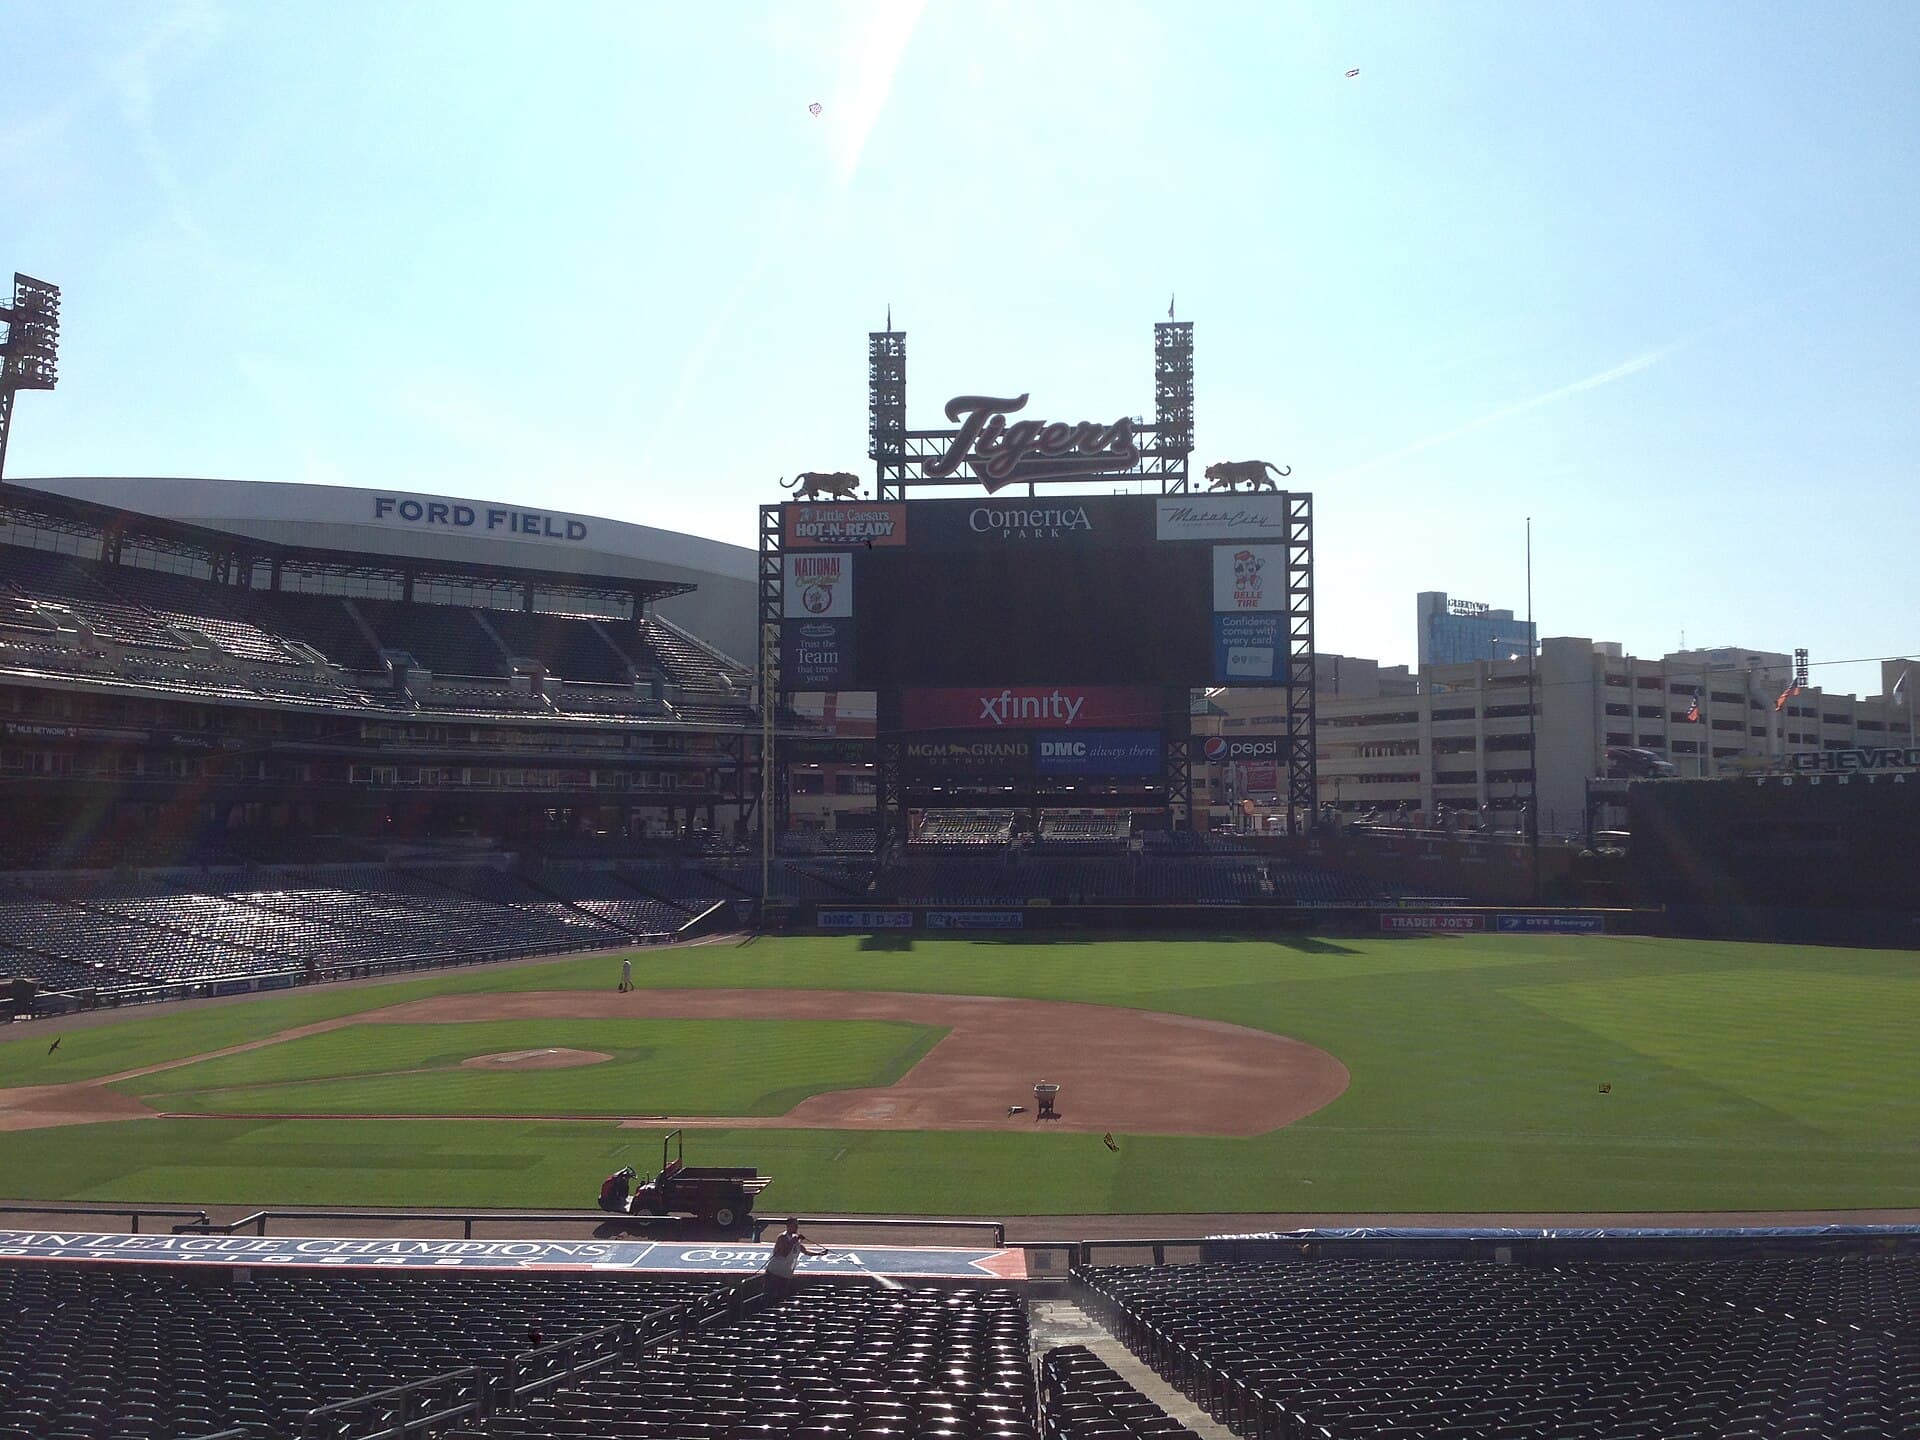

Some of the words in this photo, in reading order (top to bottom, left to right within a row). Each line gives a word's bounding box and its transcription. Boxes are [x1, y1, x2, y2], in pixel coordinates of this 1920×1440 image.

[924, 393, 1140, 482] Tigers
[375, 498, 475, 526] FORD
[488, 510, 587, 540] FIELD
[815, 511, 844, 521] Little
[848, 509, 889, 521] Caesars
[1161, 507, 1230, 522] Motor
[1228, 511, 1280, 527] City
[796, 522, 895, 537] HOT-N-READY
[1003, 529, 1059, 538] PARK
[1233, 591, 1262, 599] BELLE
[1222, 617, 1277, 627] Confidence
[1256, 626, 1277, 635] with
[801, 640, 820, 648] Trust
[823, 640, 836, 648] the
[1222, 638, 1249, 647] every
[796, 648, 839, 664] Team
[798, 665, 814, 673] that
[816, 665, 838, 673] treats
[806, 674, 829, 683] yours
[980, 690, 1084, 724] xfinity
[17, 725, 32, 734] MLB
[33, 726, 66, 737] NETWORK
[907, 744, 946, 757] MGM
[971, 743, 1028, 757] GRAND
[1040, 742, 1087, 757] DMC
[1090, 743, 1126, 760] always
[1129, 743, 1157, 757] there
[1230, 740, 1277, 757] pepsi
[929, 757, 1006, 765] DETROIT
[1757, 774, 1905, 786] FOUNTA
[1392, 917, 1437, 928] TRADER
[1440, 918, 1473, 928] JOE'S
[1554, 918, 1595, 929] Energy
[81, 1236, 288, 1251] LEAGUE
[295, 1239, 614, 1257] CHAMPIONS
[177, 1253, 464, 1266] TIGERS
